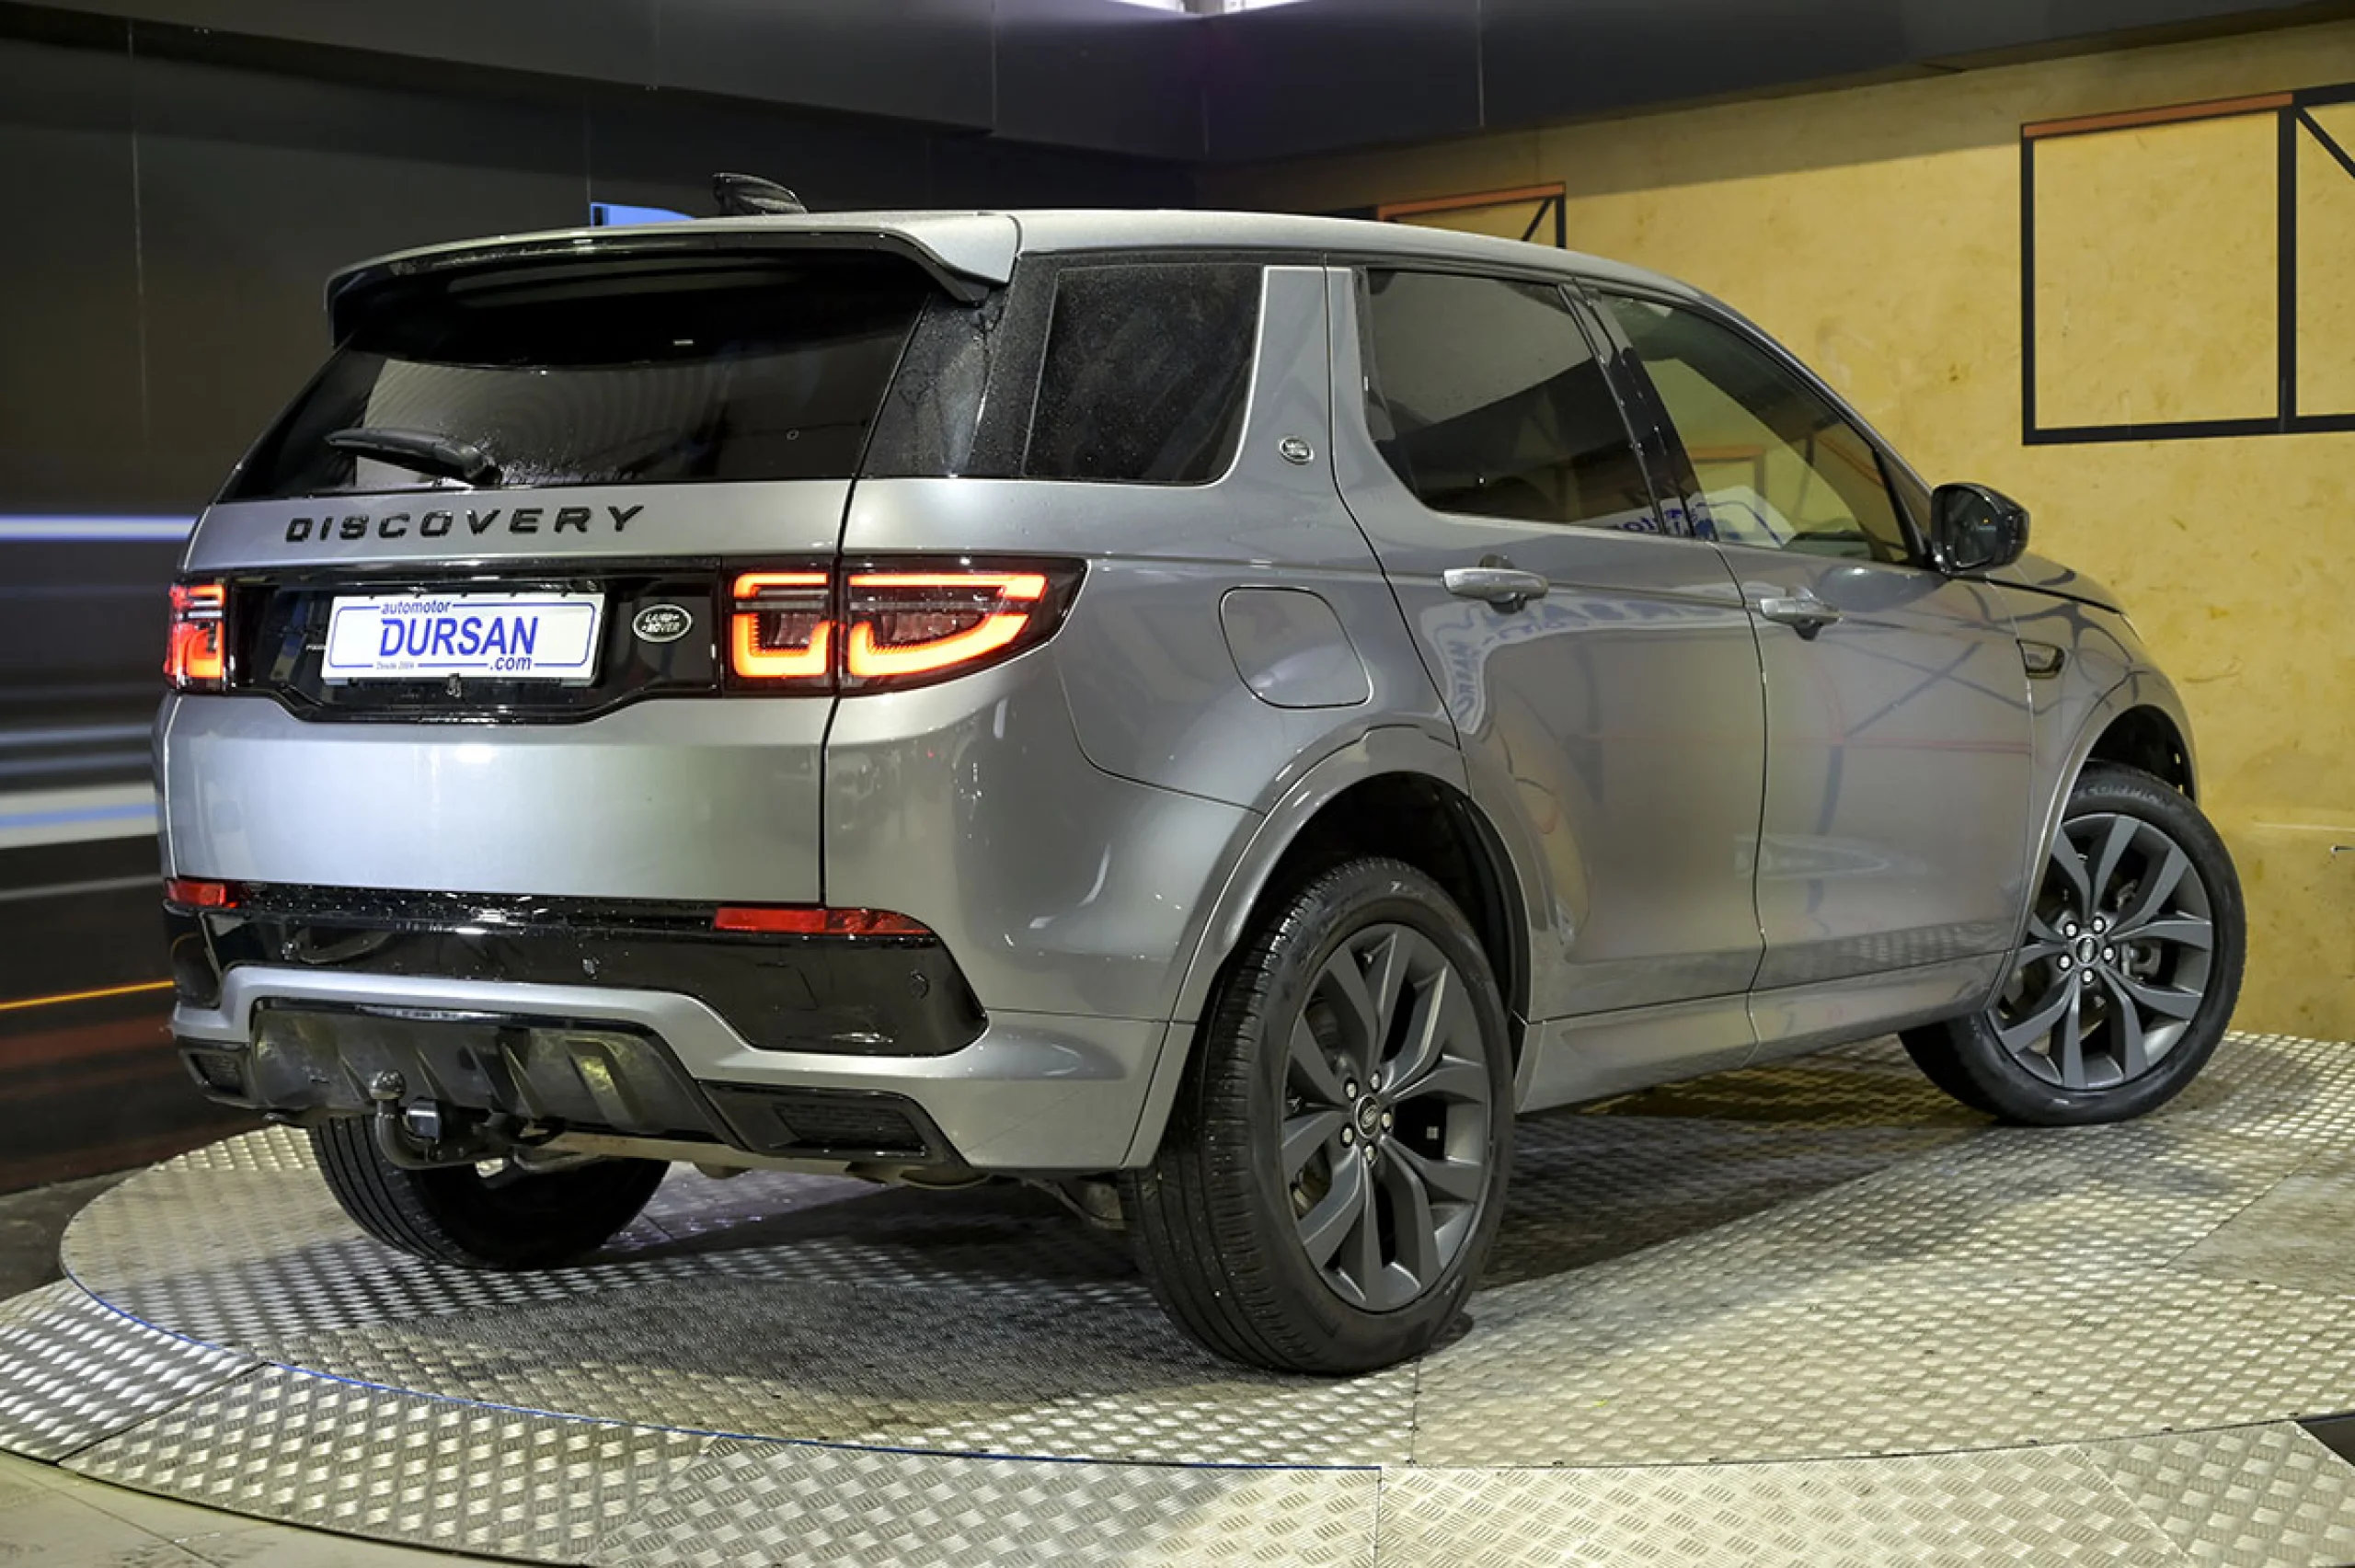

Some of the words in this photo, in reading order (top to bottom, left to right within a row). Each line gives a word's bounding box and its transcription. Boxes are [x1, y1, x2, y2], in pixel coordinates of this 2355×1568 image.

[285, 505, 644, 543] DISCOVERY
[381, 600, 452, 614] automotor
[379, 616, 538, 657] DURSAN
[489, 656, 532, 671] .com
